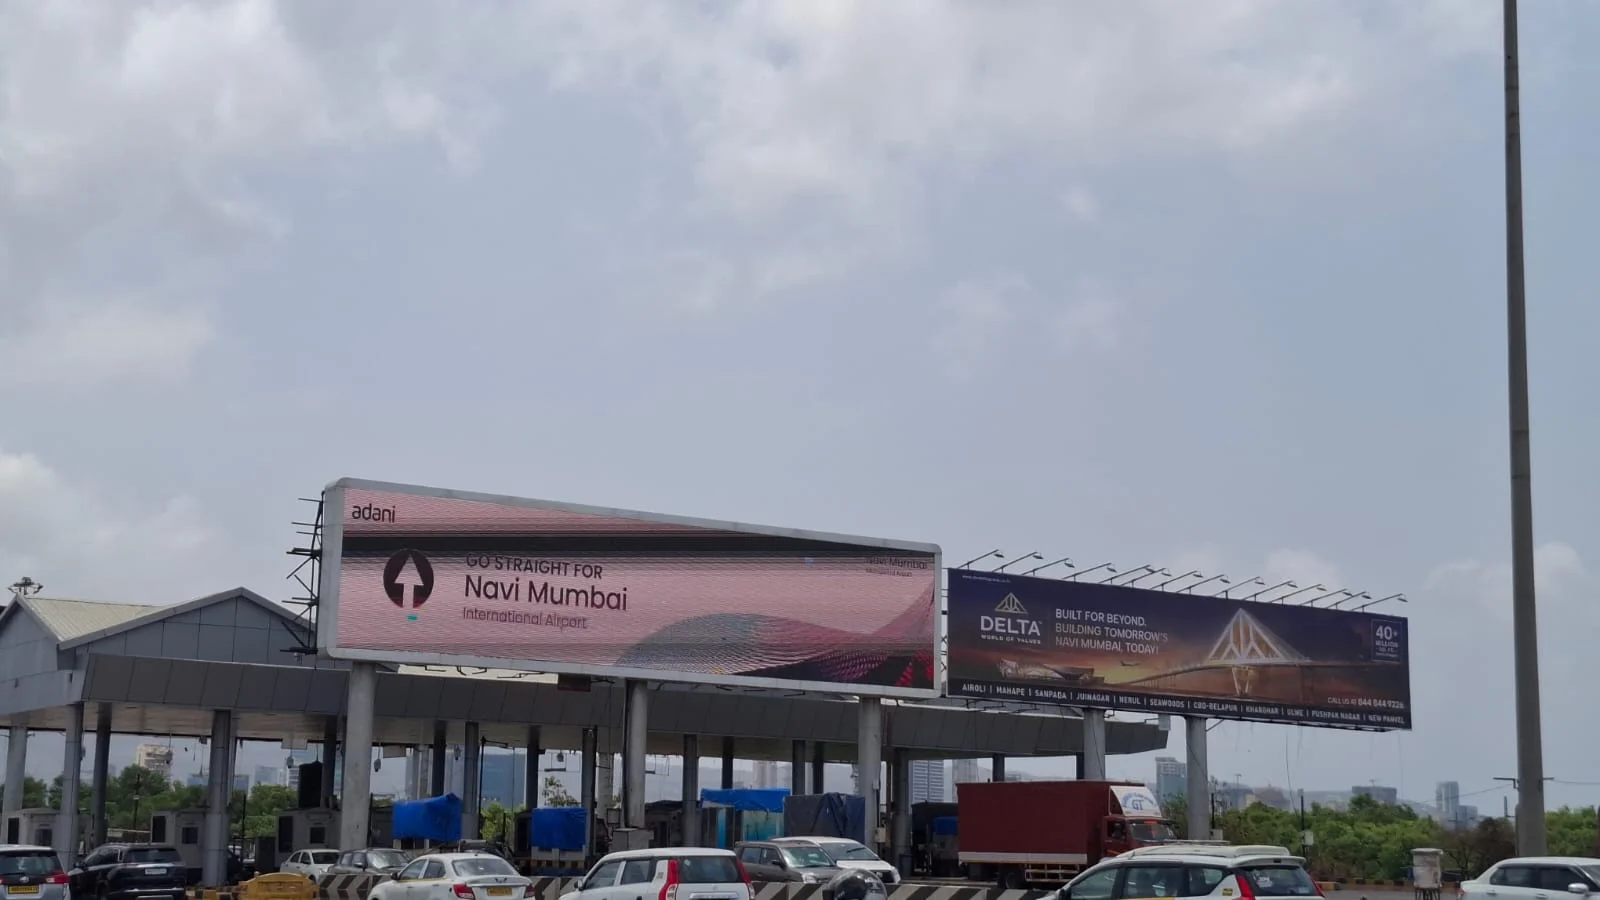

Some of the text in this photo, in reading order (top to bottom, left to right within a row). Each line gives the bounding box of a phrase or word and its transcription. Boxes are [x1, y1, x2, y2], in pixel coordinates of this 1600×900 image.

[352, 504, 396, 523] adani
[466, 553, 603, 579] GO STRAIGHT FOR
[465, 574, 627, 611] Navi Mumbai
[463, 607, 587, 632] International Airport
[980, 615, 1041, 637] DELTA
[1055, 608, 1147, 626] BUILT FOR BEYOND.
[1055, 623, 1169, 642] BUILDING TOMORROW'S
[1055, 636, 1160, 654] NAVI MUMBAI, TODAY!
[962, 683, 986, 693] AIROLI
[996, 686, 1025, 696] MAHAPE
[1034, 689, 1067, 700] SANPADA
[1076, 692, 1110, 704] JUINAGAR
[1119, 696, 1141, 705] NERUL
[1149, 698, 1185, 708] SEAWOODS
[1193, 701, 1238, 712] CBD-BELAPUR
